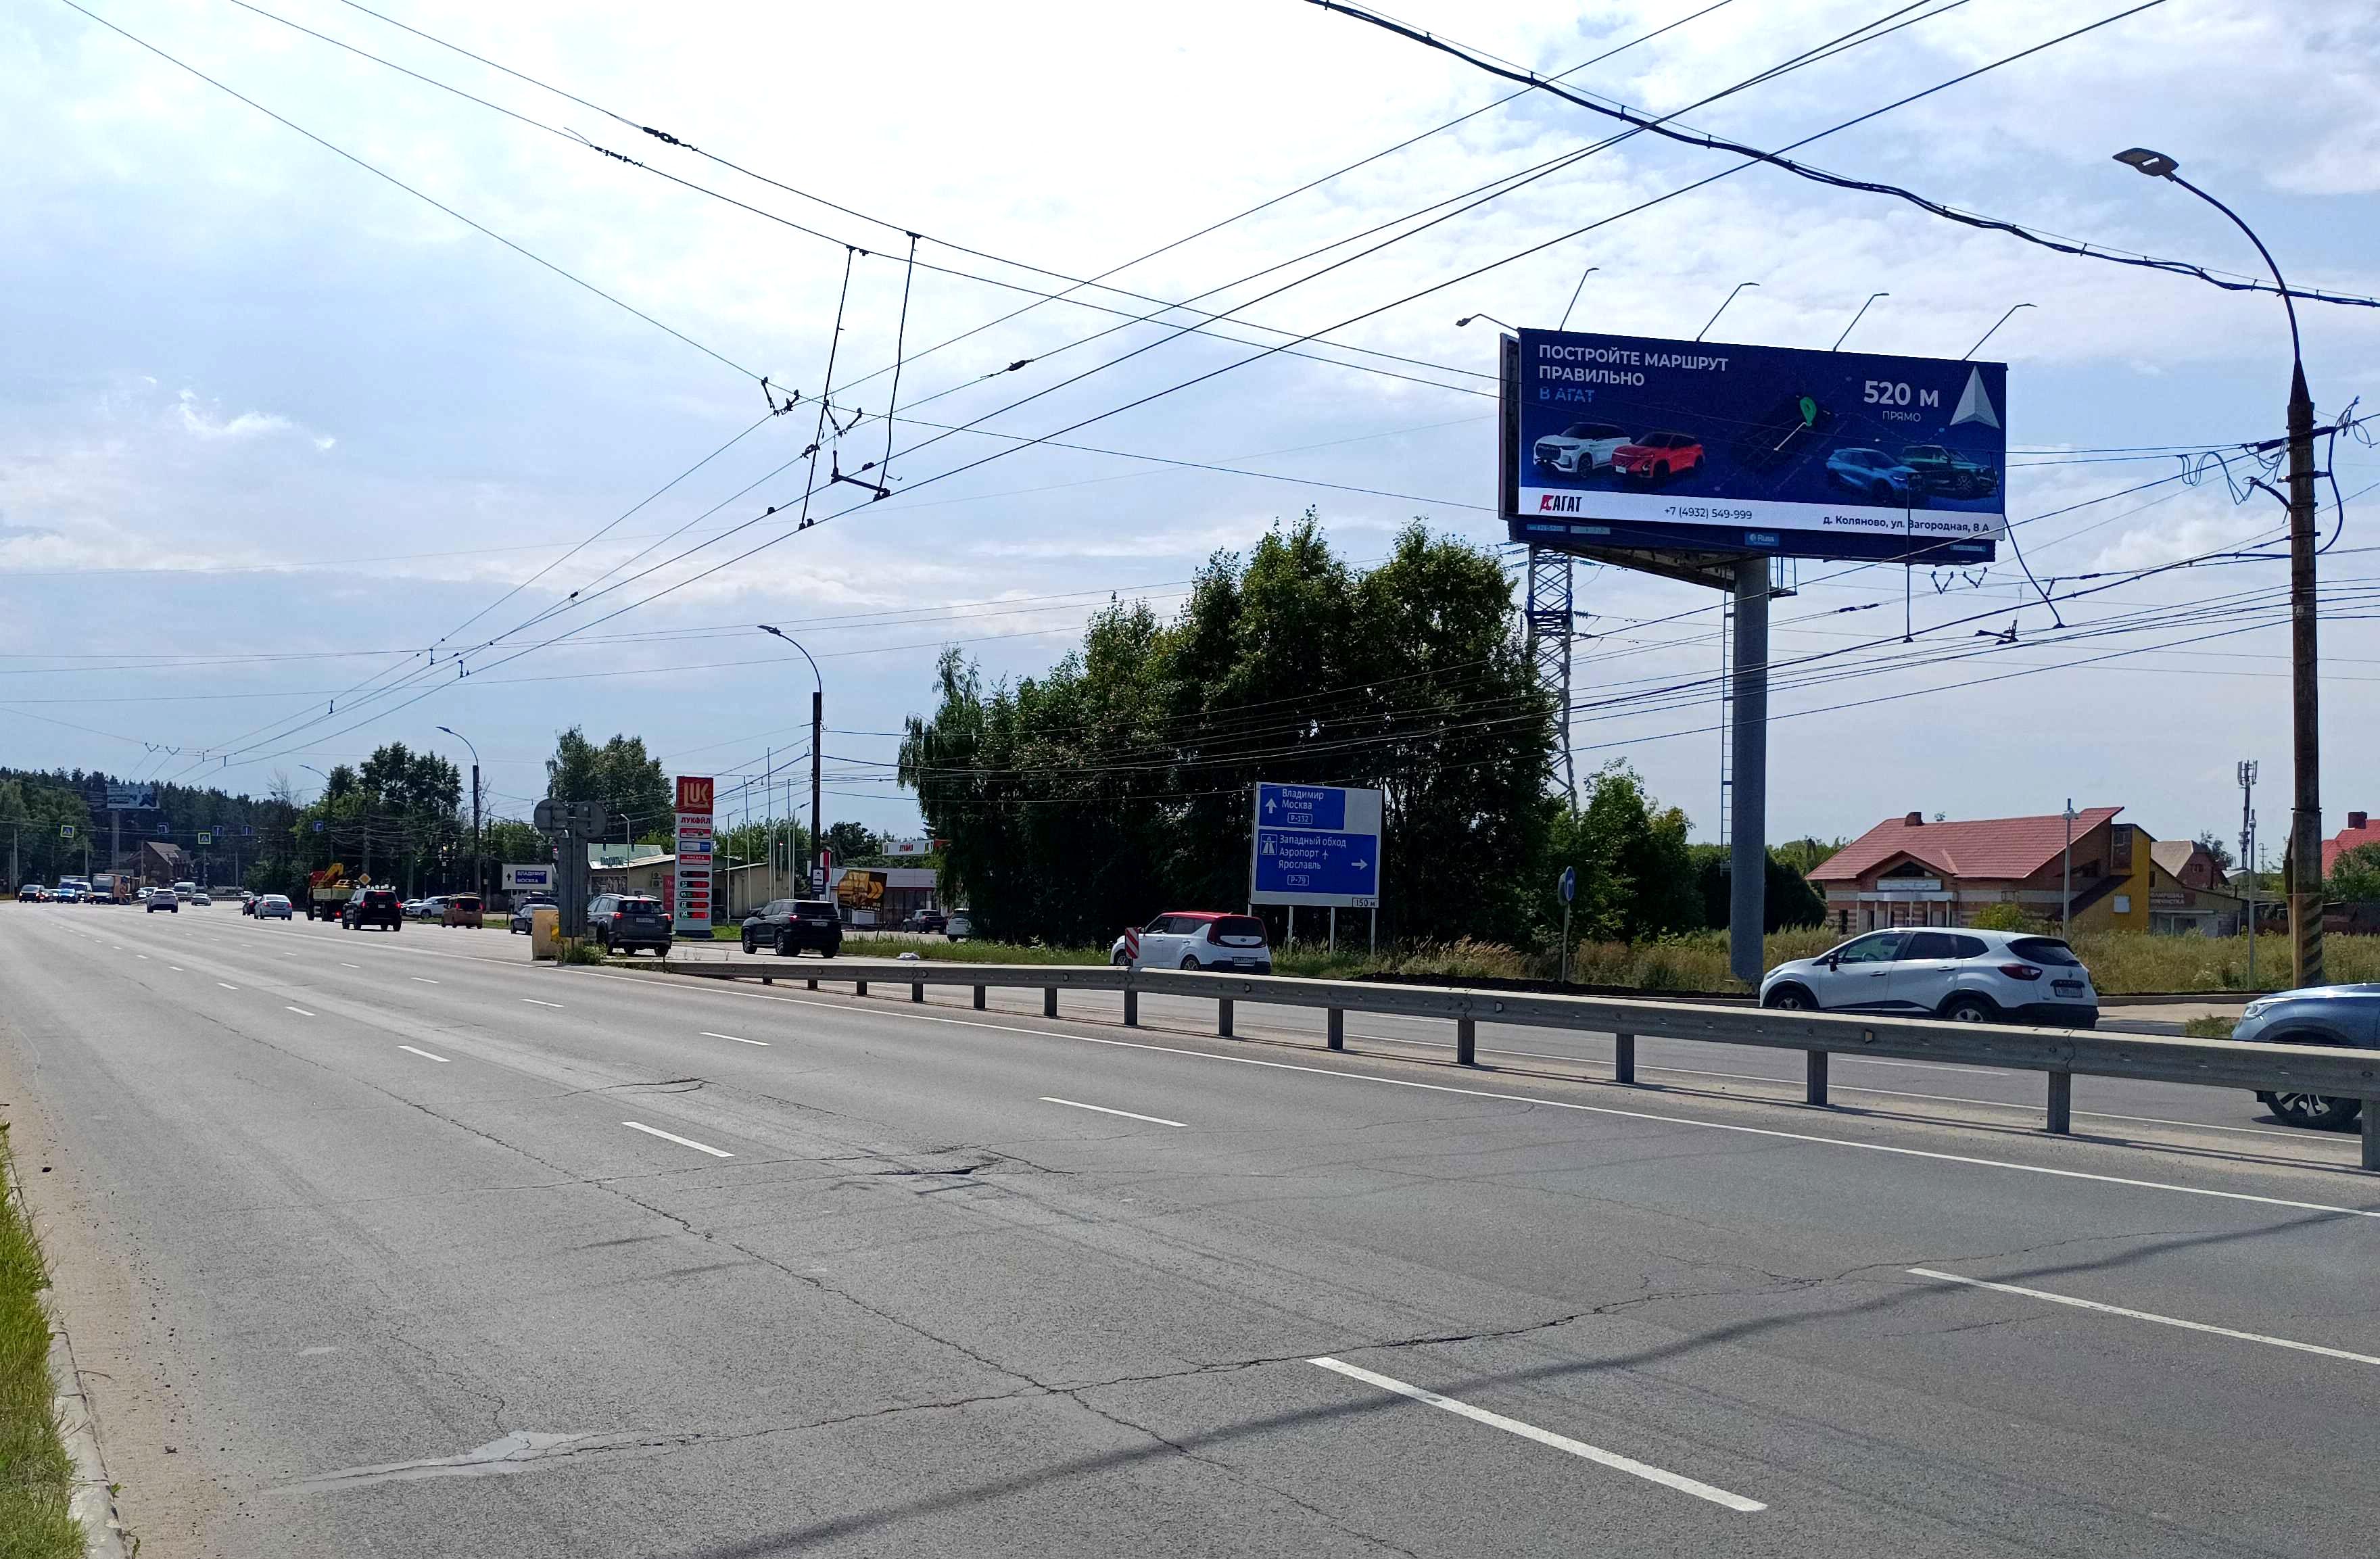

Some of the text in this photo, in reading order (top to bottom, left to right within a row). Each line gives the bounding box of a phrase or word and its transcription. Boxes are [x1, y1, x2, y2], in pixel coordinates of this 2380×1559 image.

[1539, 344, 1729, 372] ПОСТРОЙТЕ МАРШРУТ
[1539, 365, 1645, 387] ПРАВИЛЬНО
[1540, 386, 1595, 402] В АГАТ
[1863, 380, 1911, 406] 520
[1882, 410, 1922, 423] ПРЯМО
[1552, 495, 1584, 512] АГАТ
[1664, 506, 1753, 519] +7 (4932) 549-999
[1823, 517, 1833, 525] д.
[1836, 515, 1888, 528] Коляново,
[1890, 520, 1905, 529] ул.
[1973, 523, 1980, 531] 8
[1282, 788, 1325, 800] Владимир
[1281, 799, 1312, 810] Москва
[1279, 834, 1347, 848] Западный обход
[1279, 848, 1319, 859] Аэропорт
[1278, 859, 1321, 870] Ярославль
